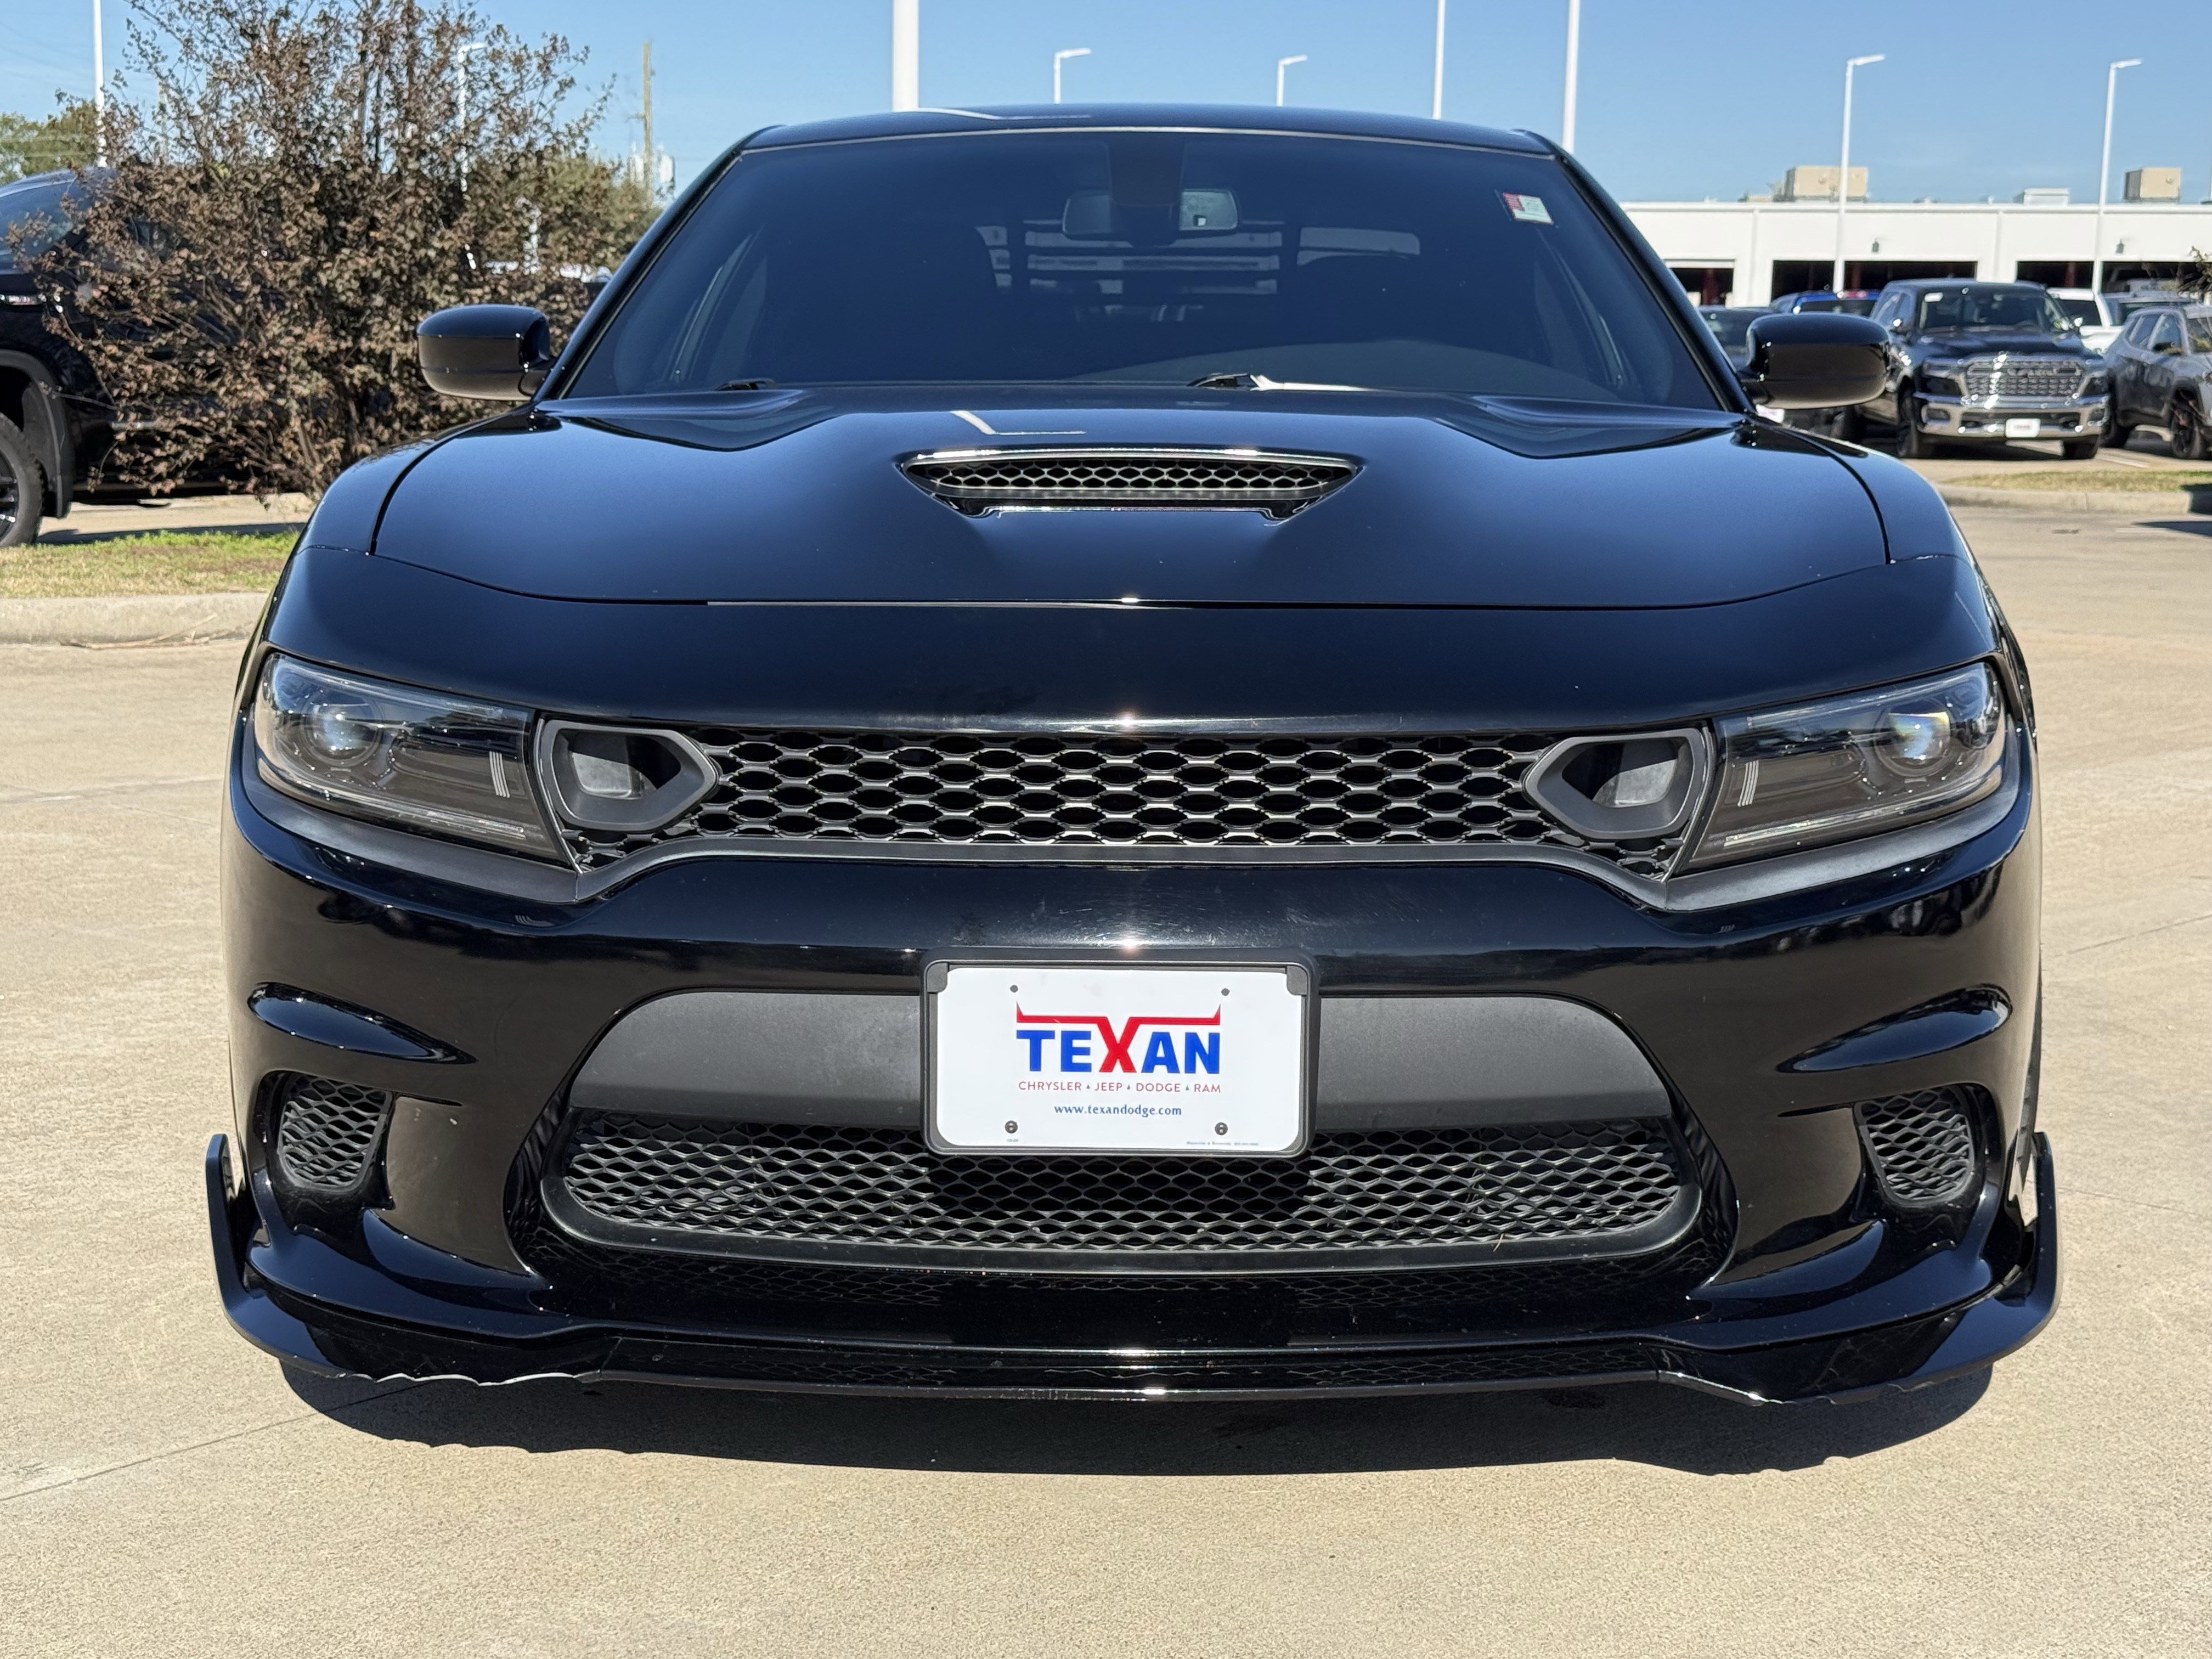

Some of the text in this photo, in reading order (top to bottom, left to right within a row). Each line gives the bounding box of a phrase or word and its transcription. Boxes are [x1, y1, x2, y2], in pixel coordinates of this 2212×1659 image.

[1016, 1009, 1221, 1075] TEXAN
[1018, 1081, 1222, 1093] CHRYSLER JEEP DODGE RAM
[1053, 1104, 1182, 1118] www.texandodge.com
